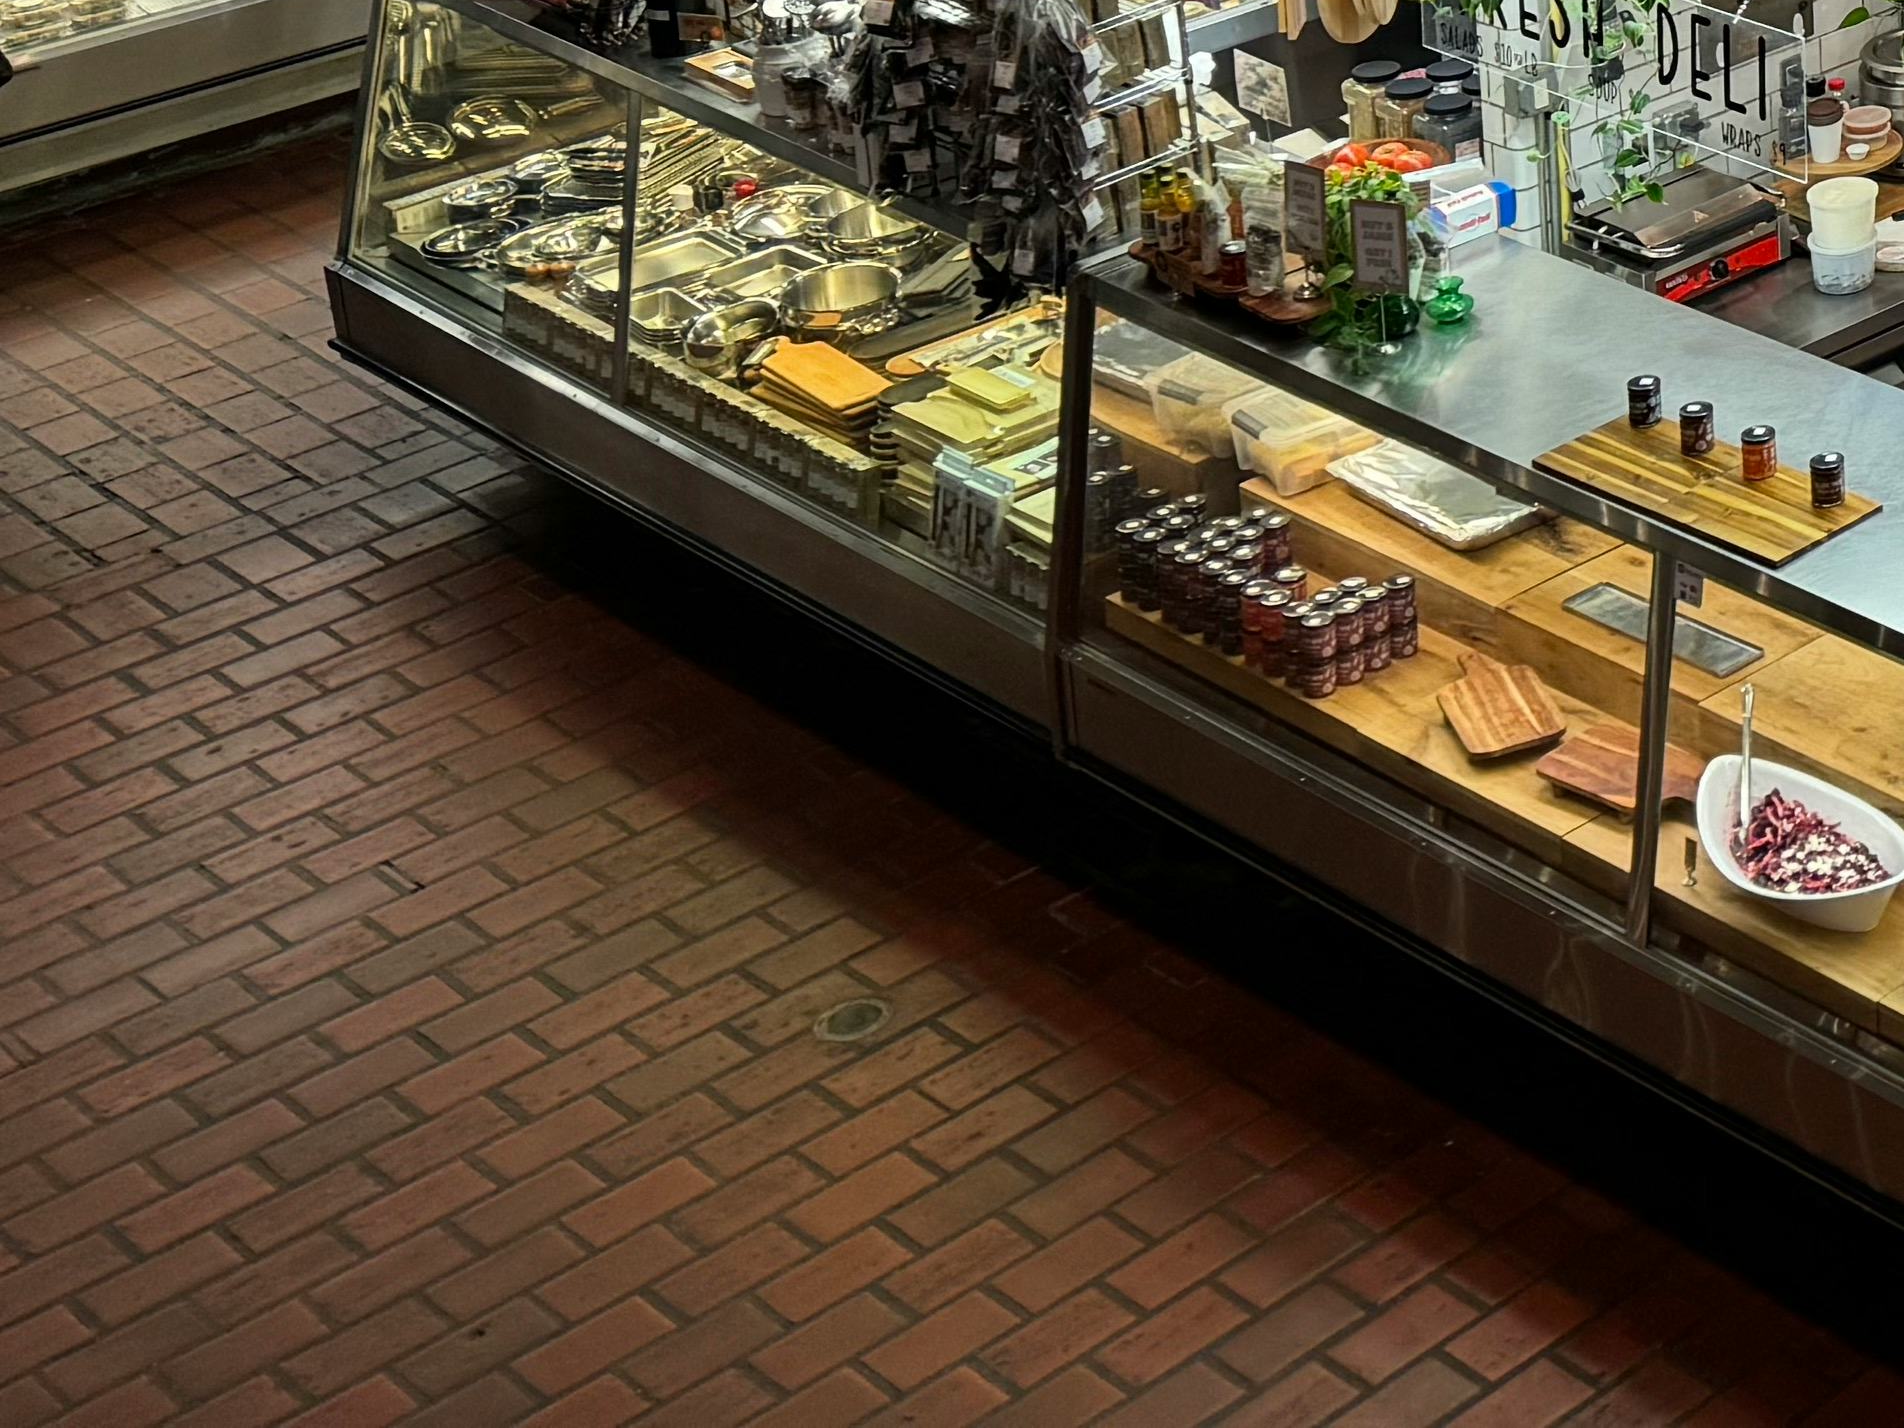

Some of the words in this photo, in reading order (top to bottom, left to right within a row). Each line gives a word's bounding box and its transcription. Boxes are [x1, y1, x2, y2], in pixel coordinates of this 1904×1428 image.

[1440, 21, 1484, 59] SALADS
[1656, 1, 1766, 122] DELI
[1719, 120, 1762, 158] WRAPS
